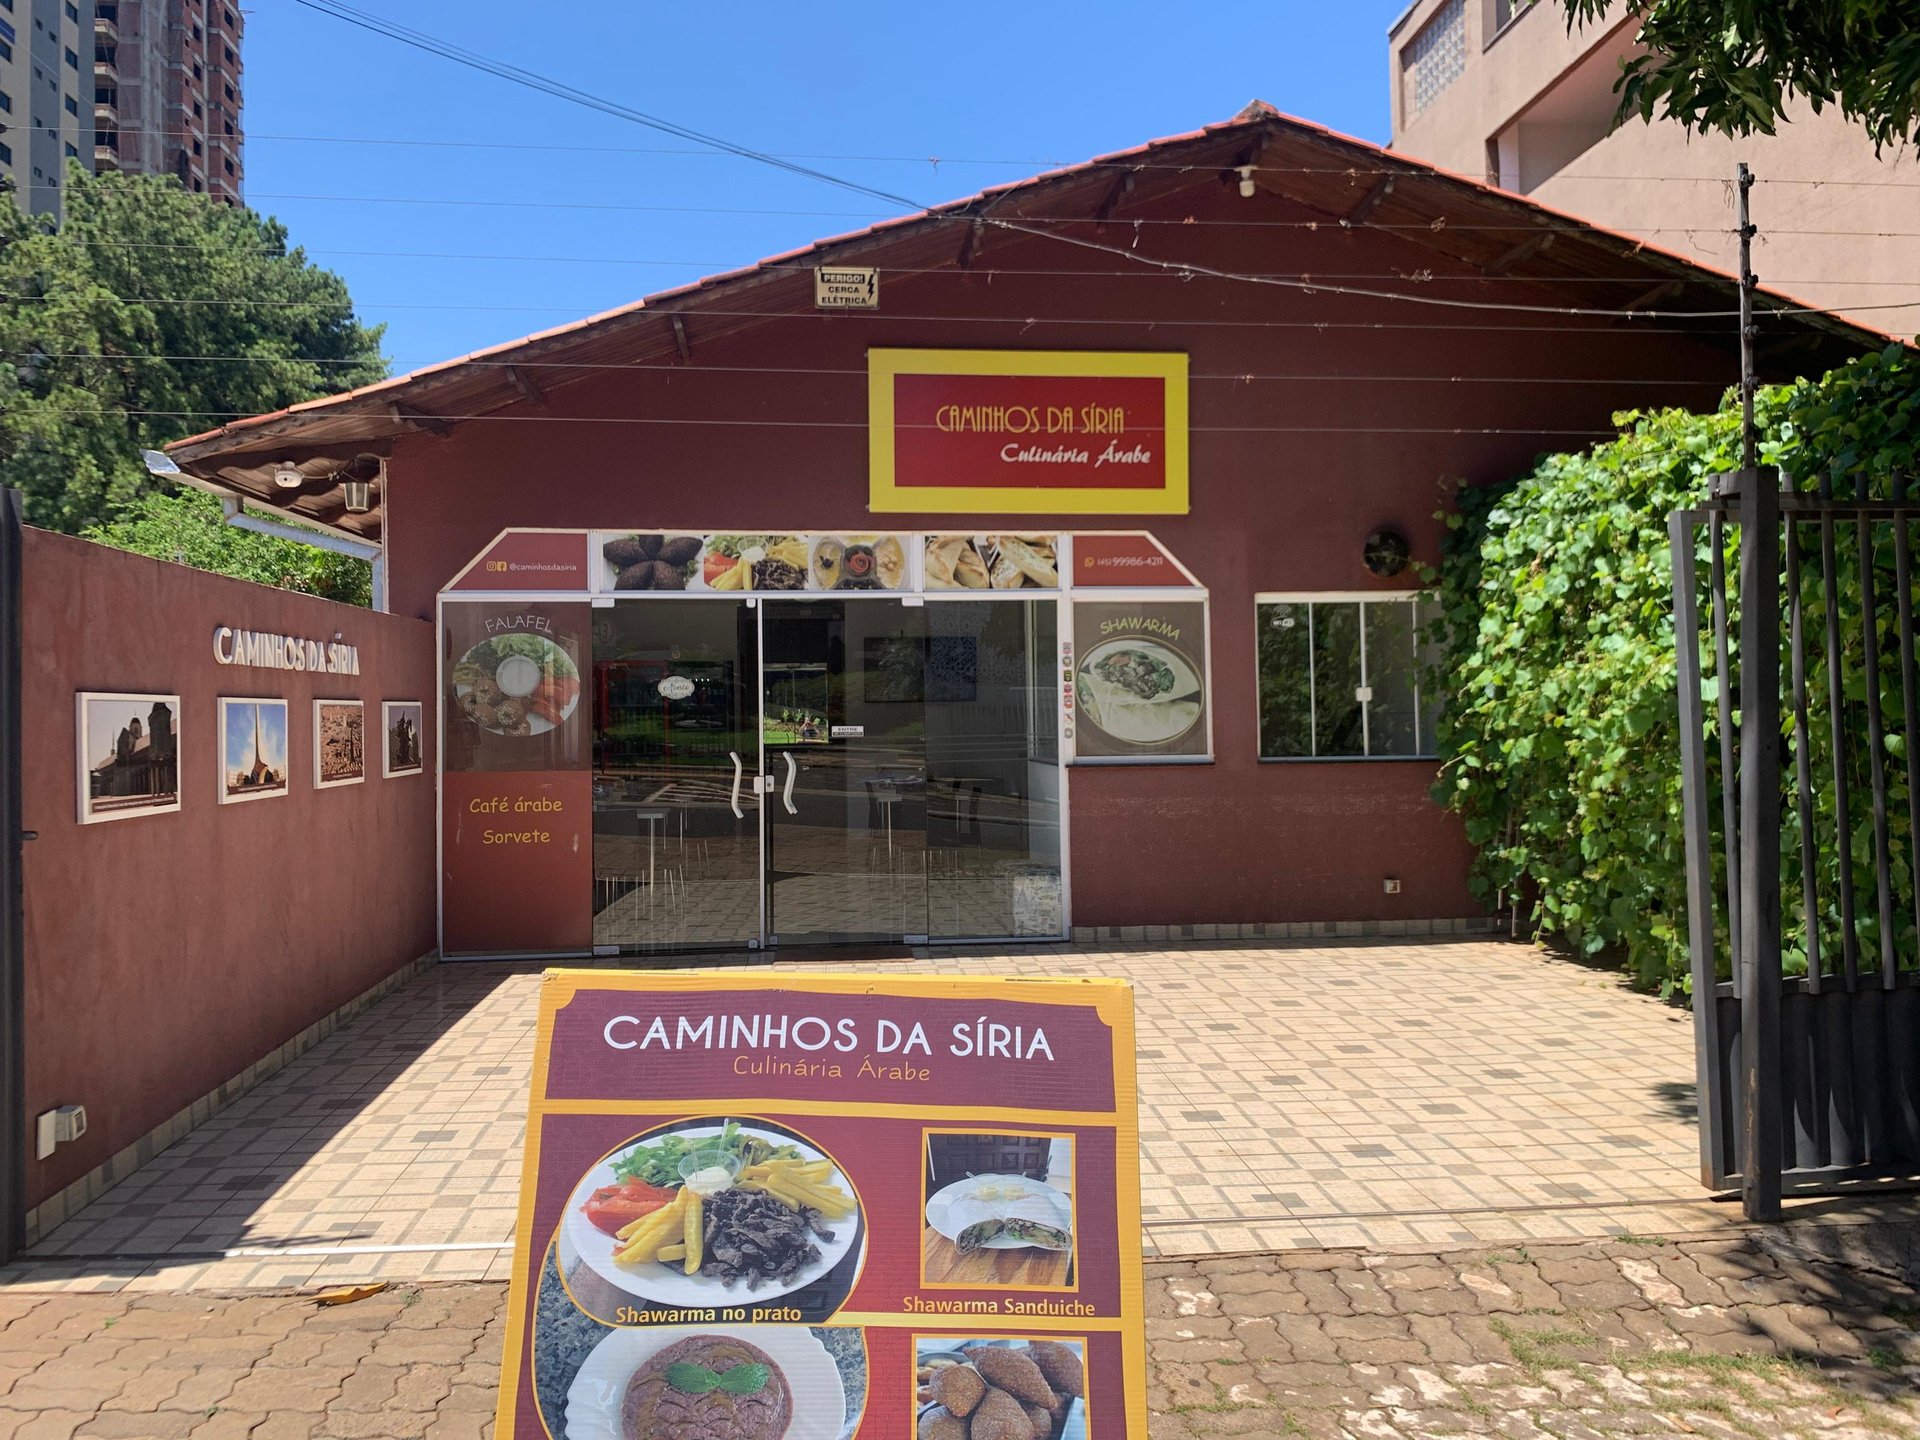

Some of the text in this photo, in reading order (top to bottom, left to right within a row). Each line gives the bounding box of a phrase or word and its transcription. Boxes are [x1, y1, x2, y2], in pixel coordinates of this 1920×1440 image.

[823, 274, 864, 283] PERIGO!
[821, 295, 867, 304] ELÉTRICA
[828, 286, 859, 294] CERCA
[936, 402, 1124, 434] CAMINHOS DA SÍRIA
[1000, 439, 1151, 468] Culinária Árabe
[509, 563, 577, 572] @caminhosdasiria
[485, 615, 553, 634] FALAFEL
[1100, 616, 1180, 641] SHAWARMA
[213, 626, 360, 675] CAMINHOS DA SÍRIA
[469, 796, 563, 814] Café árabe
[482, 829, 551, 845] Sorvete
[603, 1014, 1055, 1062] CAMINHOS DA SÍRIA
[733, 1055, 931, 1082] Culinária Árabe
[615, 1306, 802, 1326] Shawarma no prato
[902, 1296, 1096, 1317] Shawarma Sanduiche
